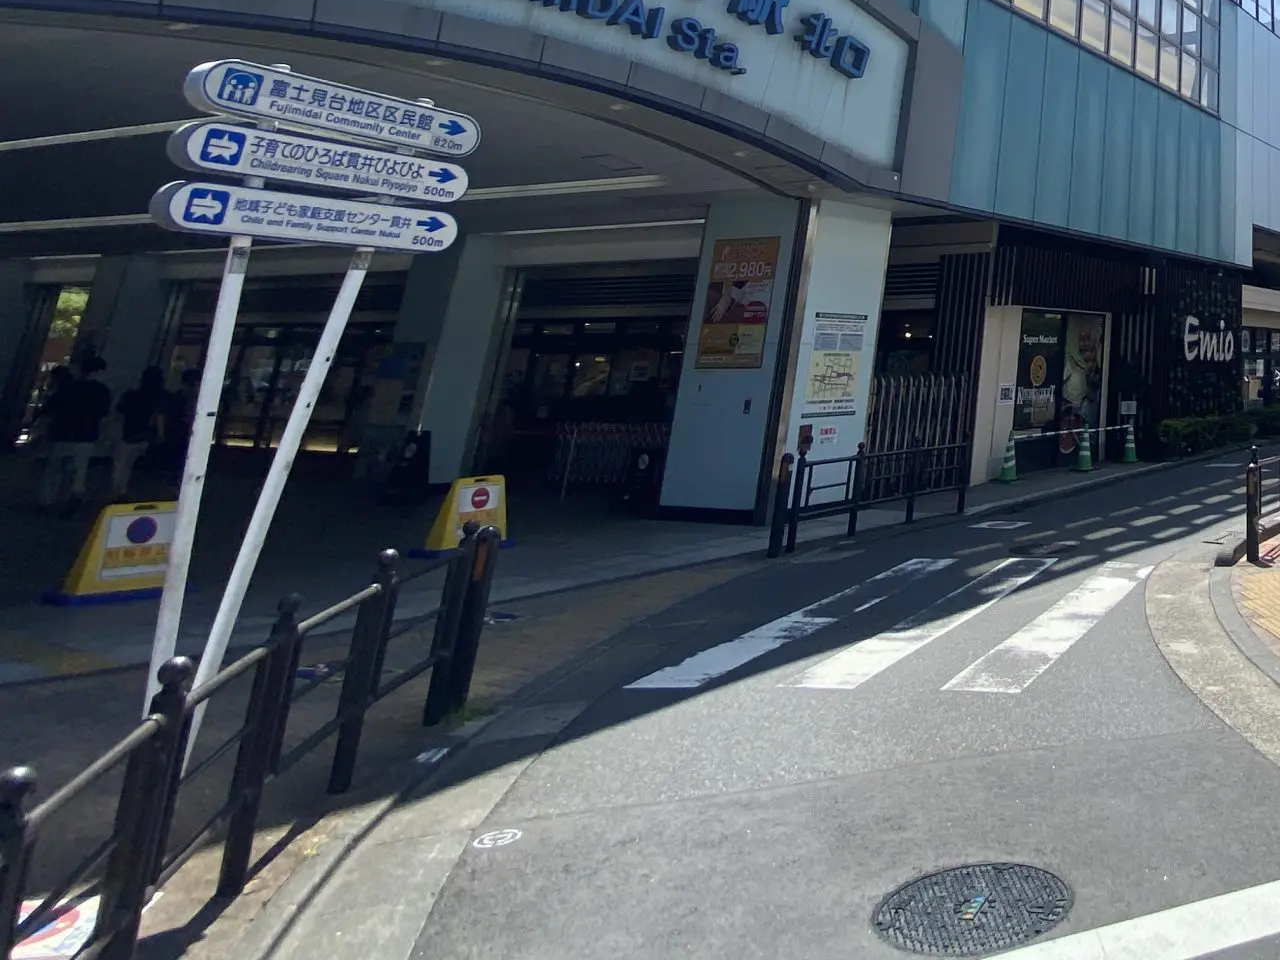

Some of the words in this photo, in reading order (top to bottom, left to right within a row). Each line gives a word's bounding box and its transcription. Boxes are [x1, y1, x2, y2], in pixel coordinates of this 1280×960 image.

[793, 12, 871, 80] 北口
[269, 78, 435, 131] 富士見台地区区民館
[269, 100, 323, 121] Fujimidai
[325, 112, 385, 135] Community
[388, 126, 422, 142] Center
[250, 157, 313, 179] Childrearing
[315, 167, 350, 183] Square
[352, 173, 379, 187] Nukui
[423, 185, 455, 200] 500m
[240, 214, 264, 225] Child
[266, 217, 283, 227] and
[286, 219, 314, 231] Family
[316, 222, 349, 234] Support
[350, 225, 377, 236] Center
[412, 234, 444, 248] 500m
[1184, 315, 1235, 362] Emio
